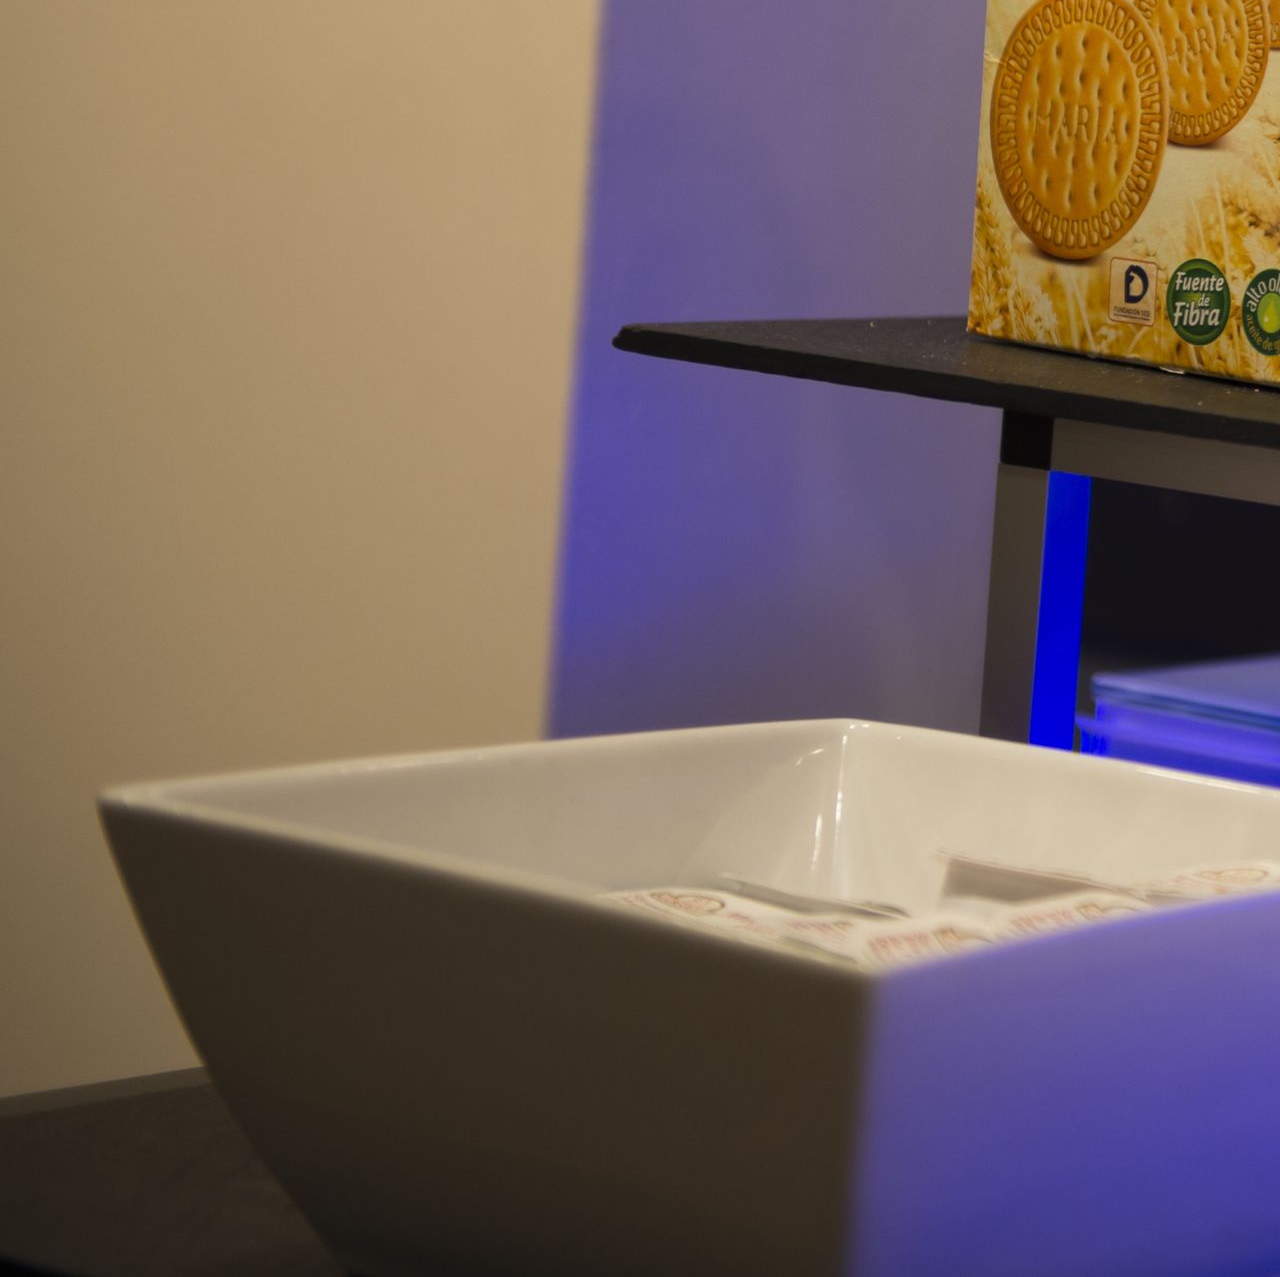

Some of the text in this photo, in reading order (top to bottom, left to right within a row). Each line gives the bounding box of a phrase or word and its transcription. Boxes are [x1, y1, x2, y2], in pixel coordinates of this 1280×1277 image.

[1175, 271, 1225, 292] Fuente
[1197, 293, 1210, 307] de
[1246, 281, 1267, 312] alto
[1173, 302, 1220, 327] Fibra
